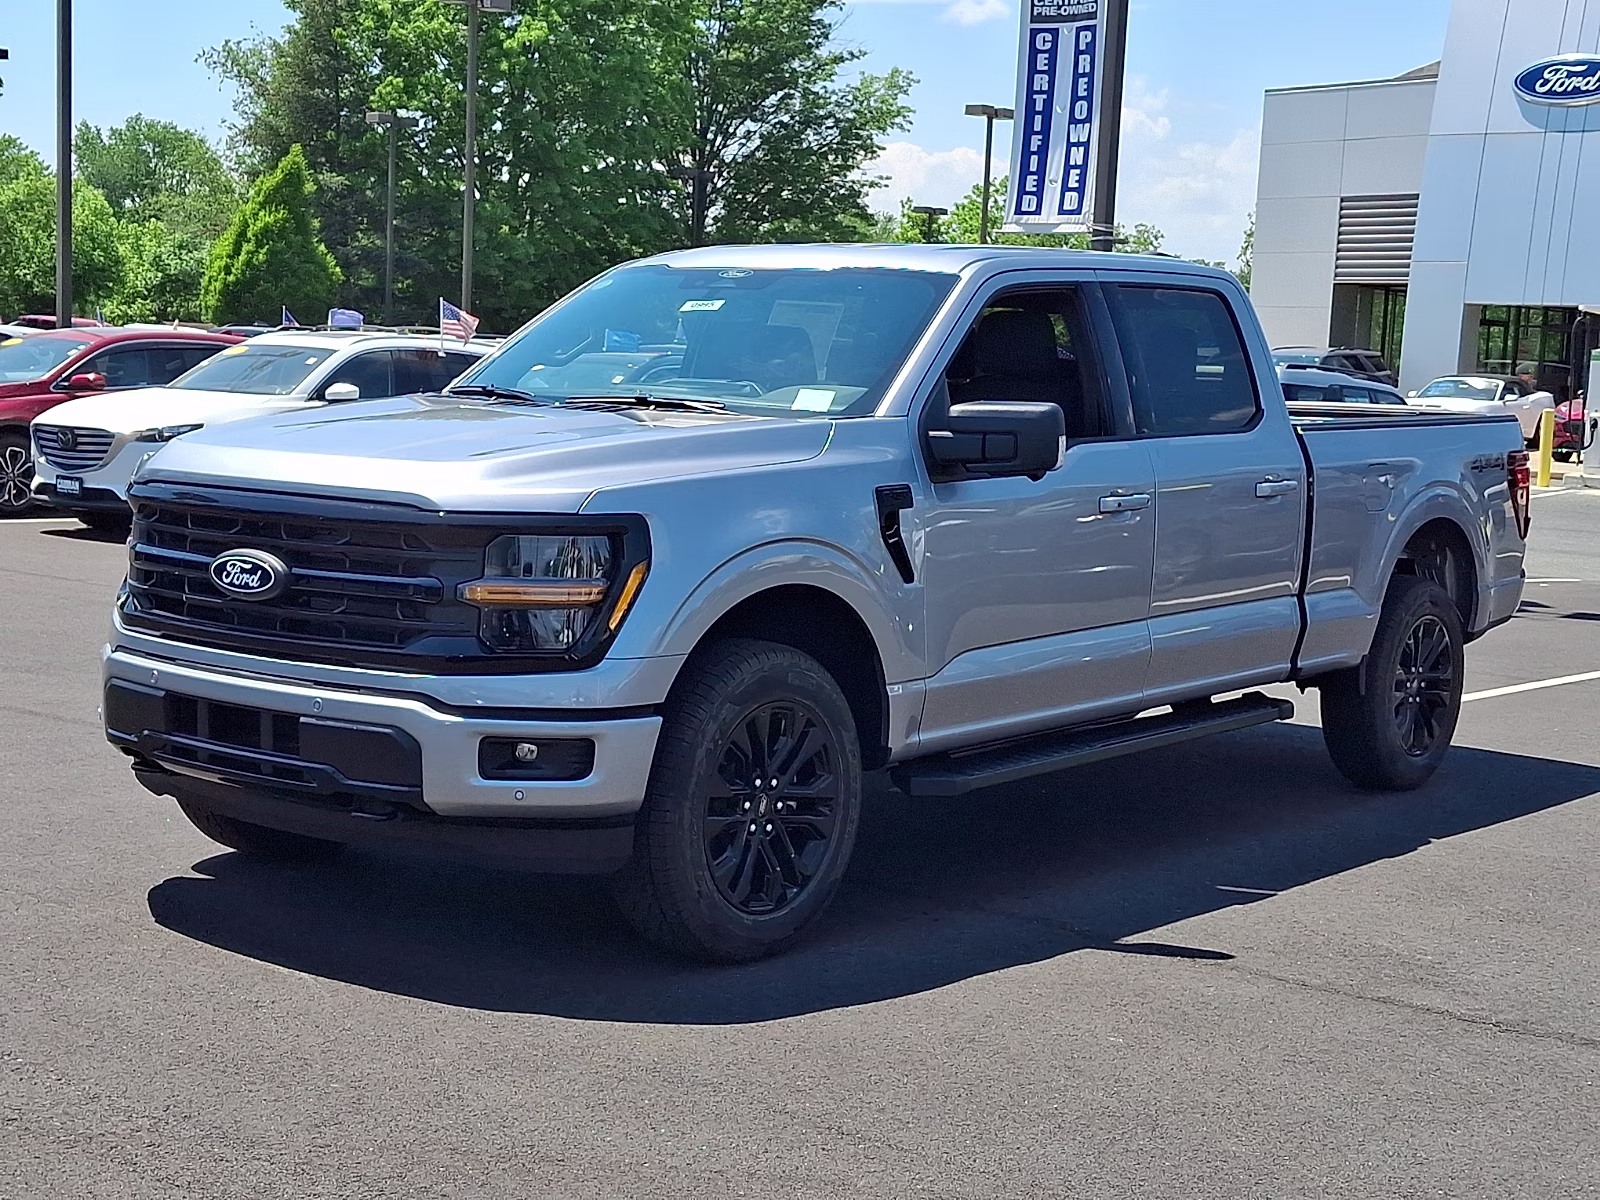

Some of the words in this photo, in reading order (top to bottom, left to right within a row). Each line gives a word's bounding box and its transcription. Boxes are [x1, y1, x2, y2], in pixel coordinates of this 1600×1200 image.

[1033, 3, 1097, 16] PRE-OWNED
[1535, 64, 1600, 93] Ford
[1020, 32, 1053, 212] CERTIFIED
[1062, 30, 1092, 211] PREOWNED
[222, 560, 262, 587] Ford
